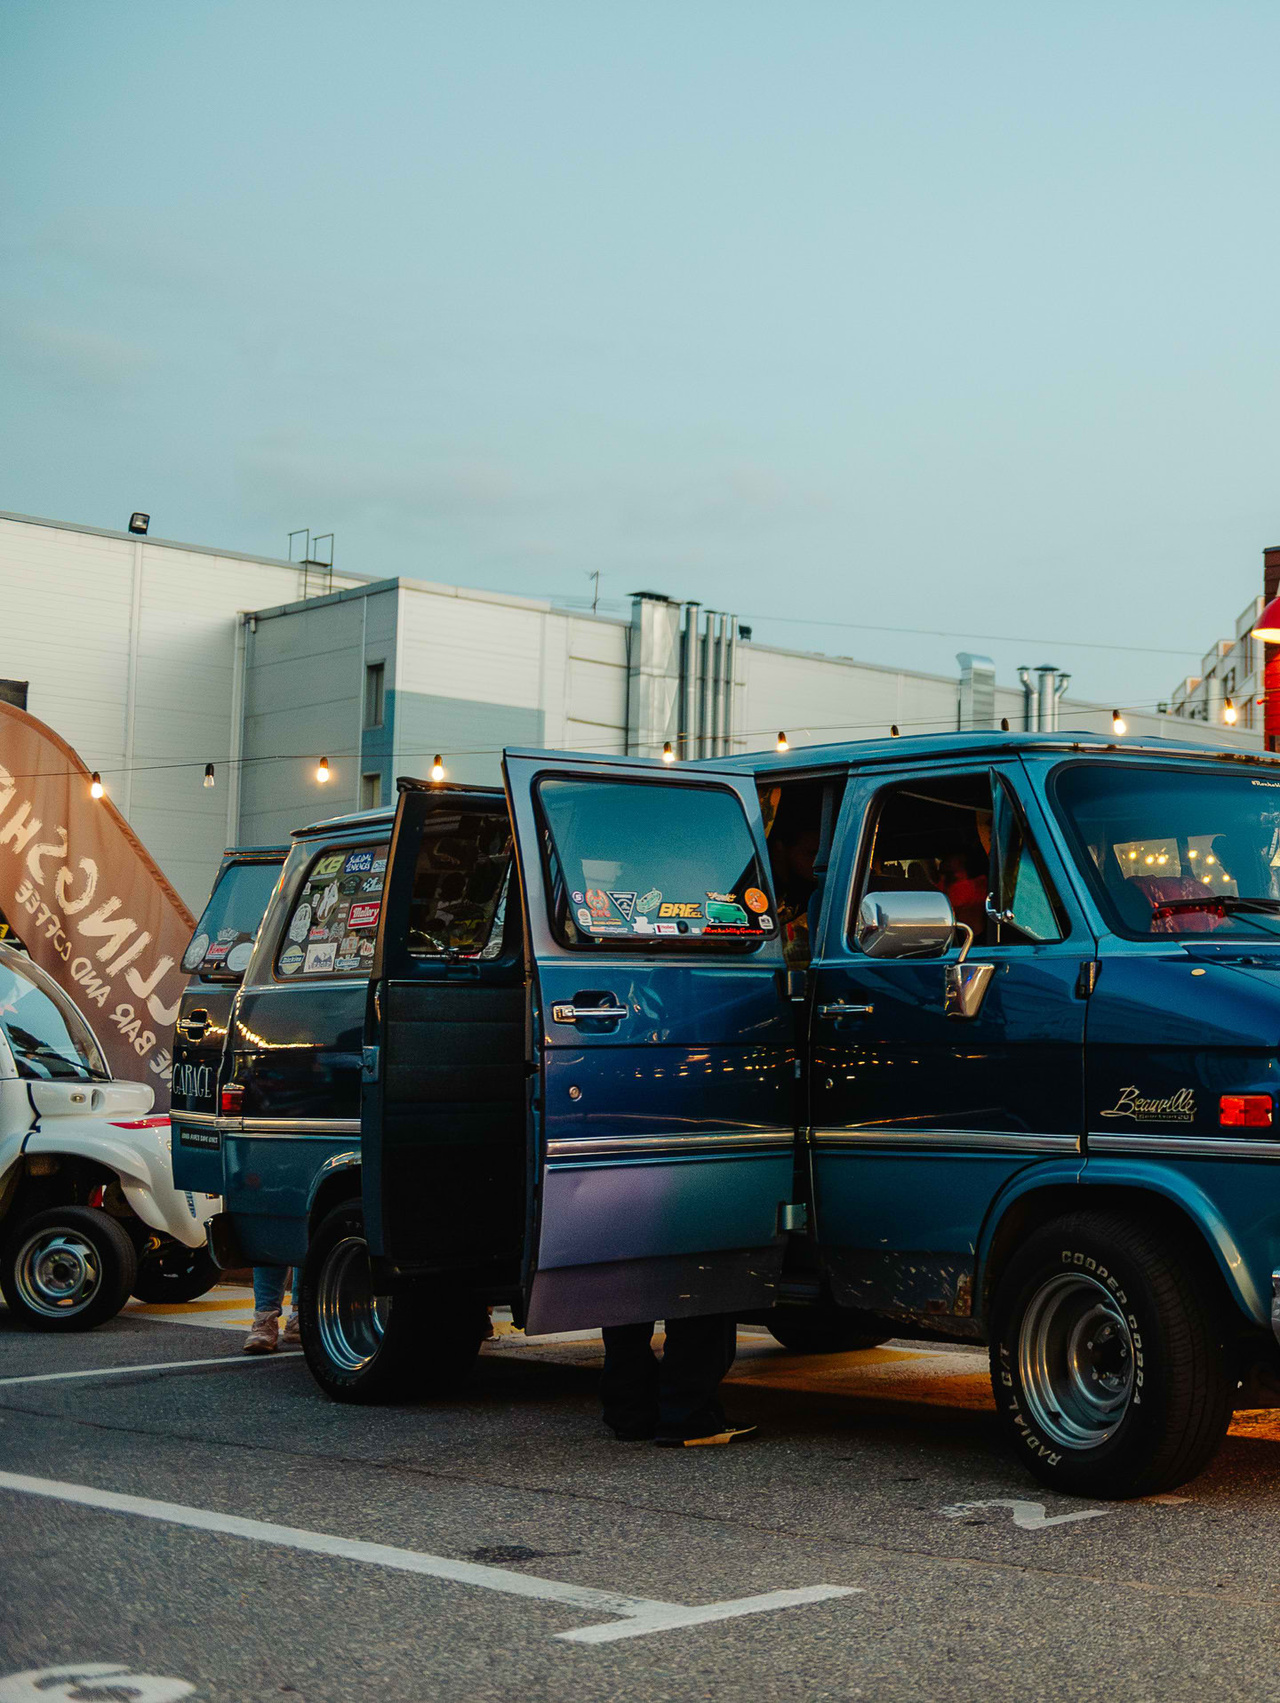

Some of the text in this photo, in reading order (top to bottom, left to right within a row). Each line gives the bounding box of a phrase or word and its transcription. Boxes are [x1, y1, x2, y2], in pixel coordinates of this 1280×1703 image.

[173, 1063, 213, 1098] GARAGE
[1099, 1085, 1197, 1118] Beauville
[1061, 1250, 1128, 1305] COOPER
[1008, 1395, 1063, 1466] RADIAL
